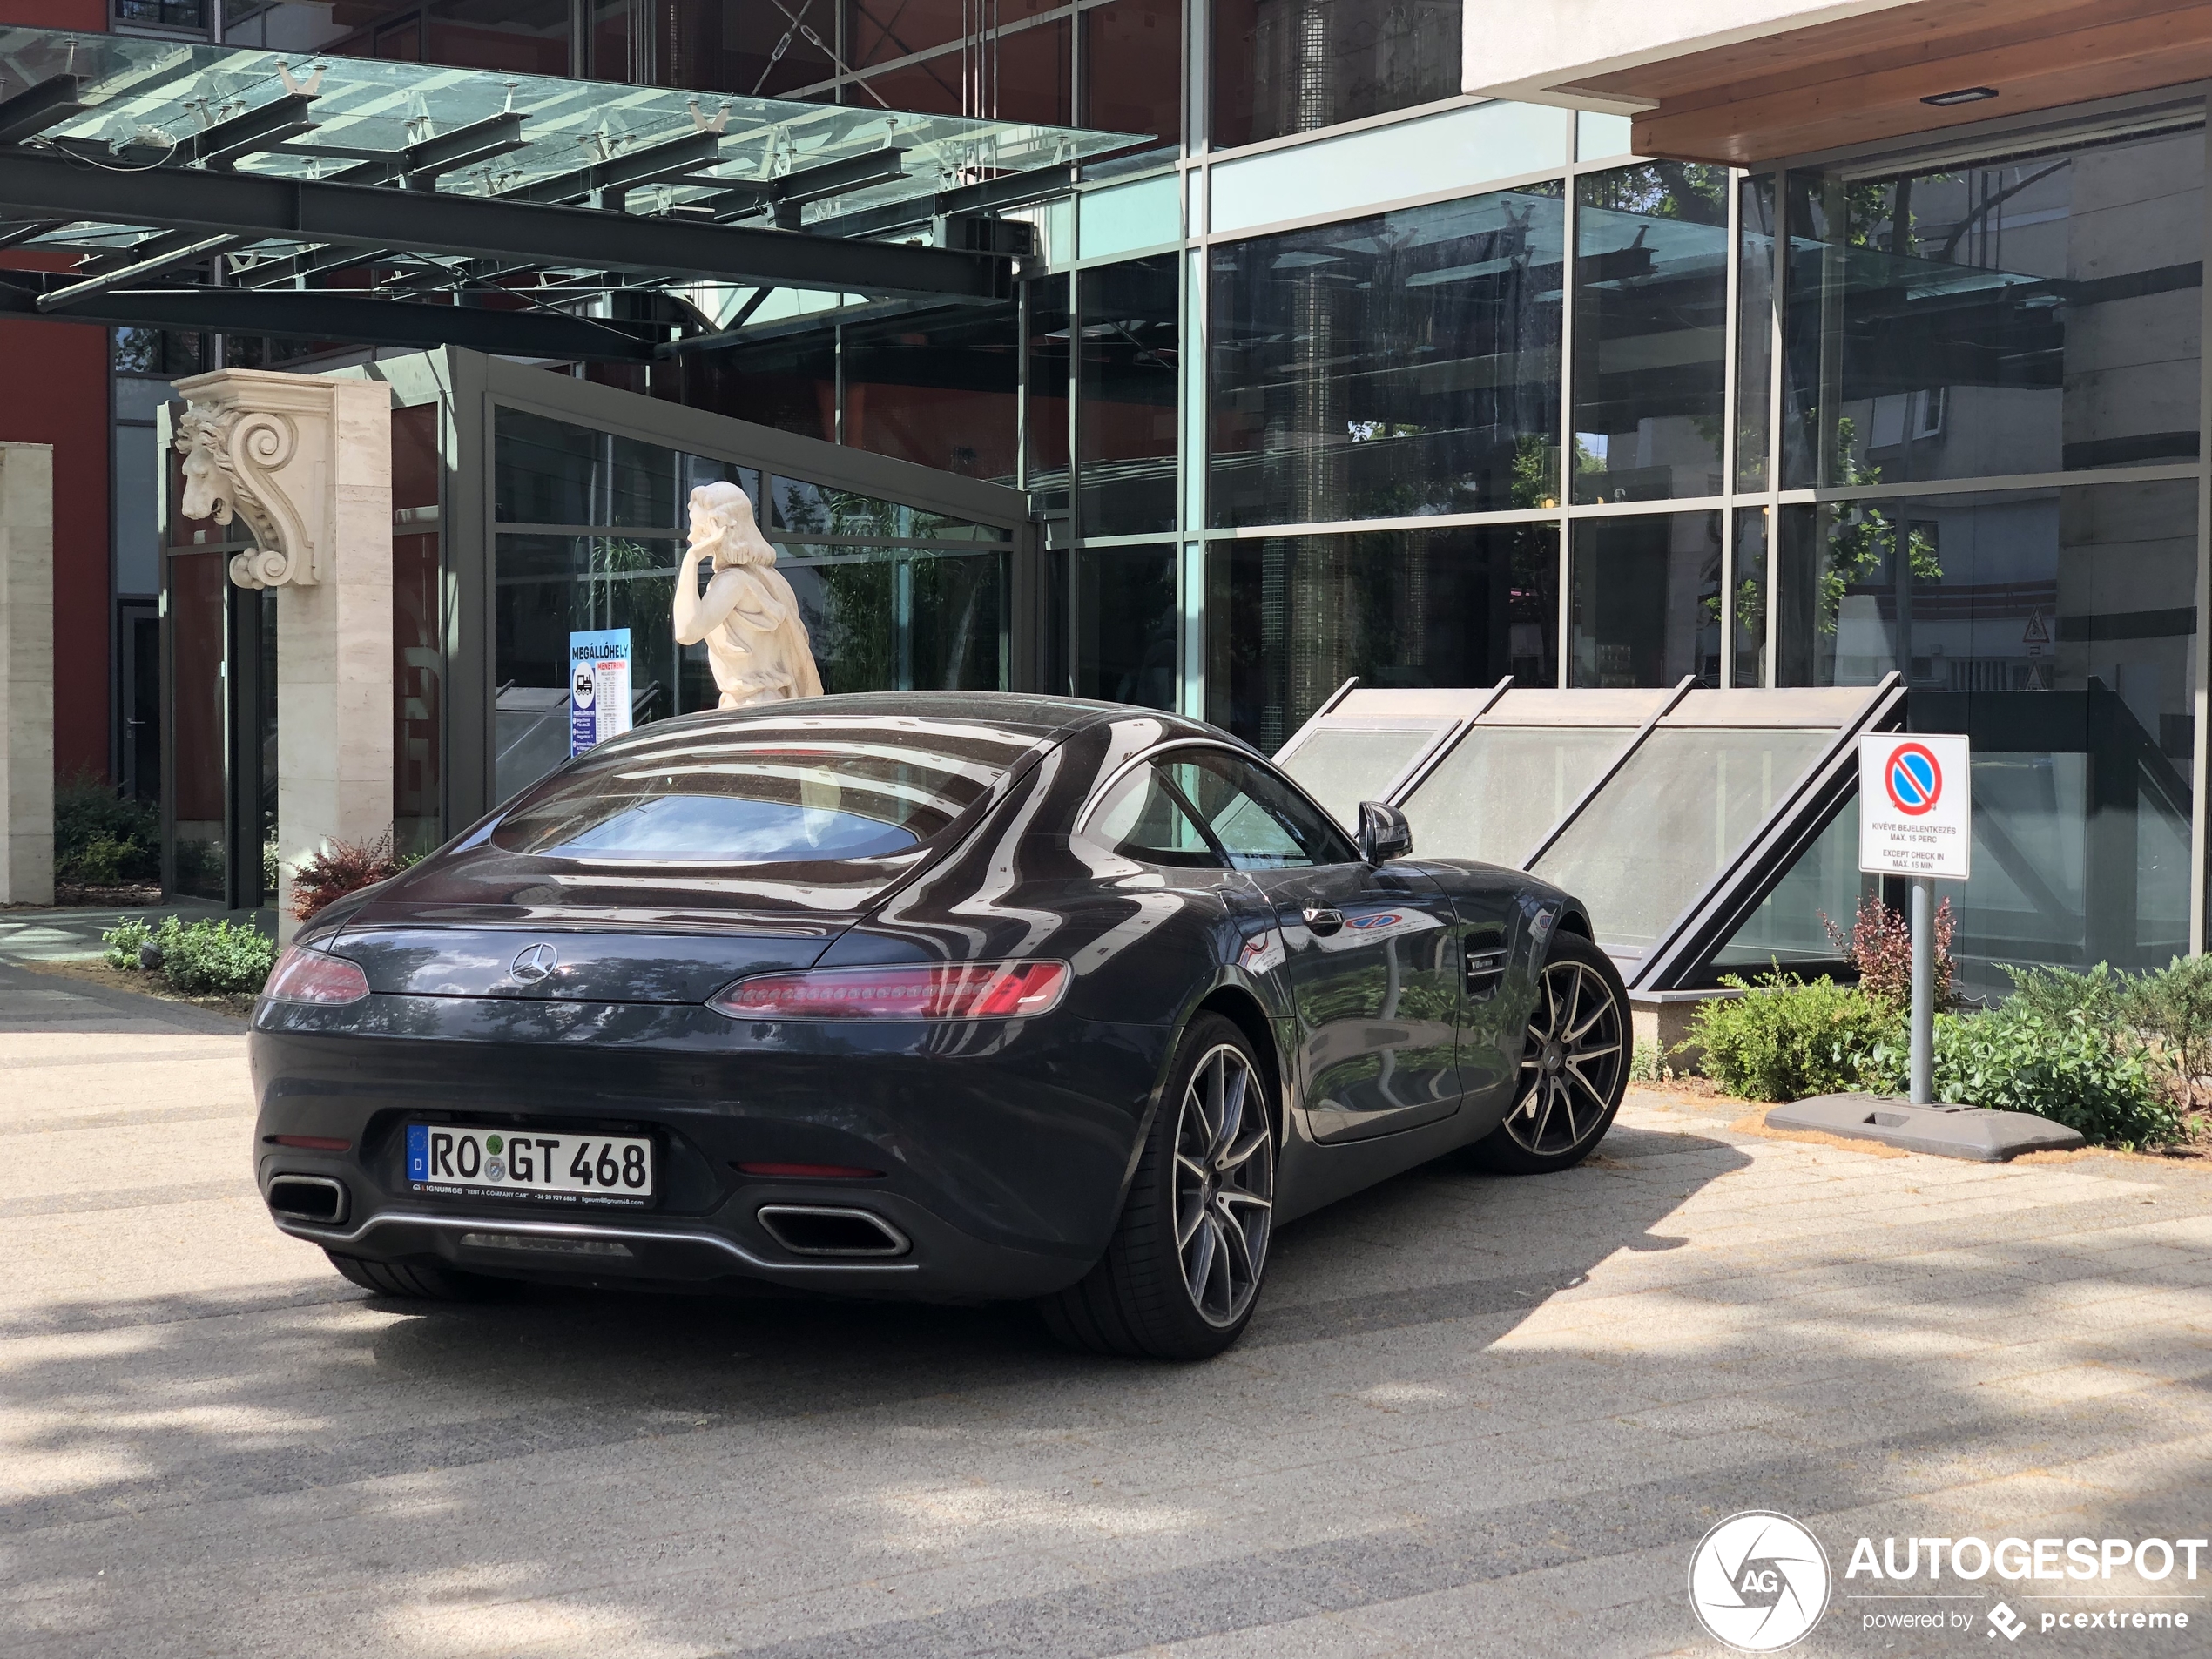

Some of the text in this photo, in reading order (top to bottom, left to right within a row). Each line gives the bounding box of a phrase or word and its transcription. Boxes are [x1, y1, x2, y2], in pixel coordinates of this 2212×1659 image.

[572, 641, 629, 660] MEGÁLLÓHELY
[597, 661, 625, 670] MENETREND
[1872, 822, 1956, 835] KIVÉVE BEJELENTKEZÉS
[1883, 849, 1910, 858] EXCEPT
[1911, 851, 1936, 860] CHECK
[414, 1158, 422, 1171] D
[430, 1132, 646, 1189] RO GT 468
[421, 1185, 463, 1195] LIGNUM68
